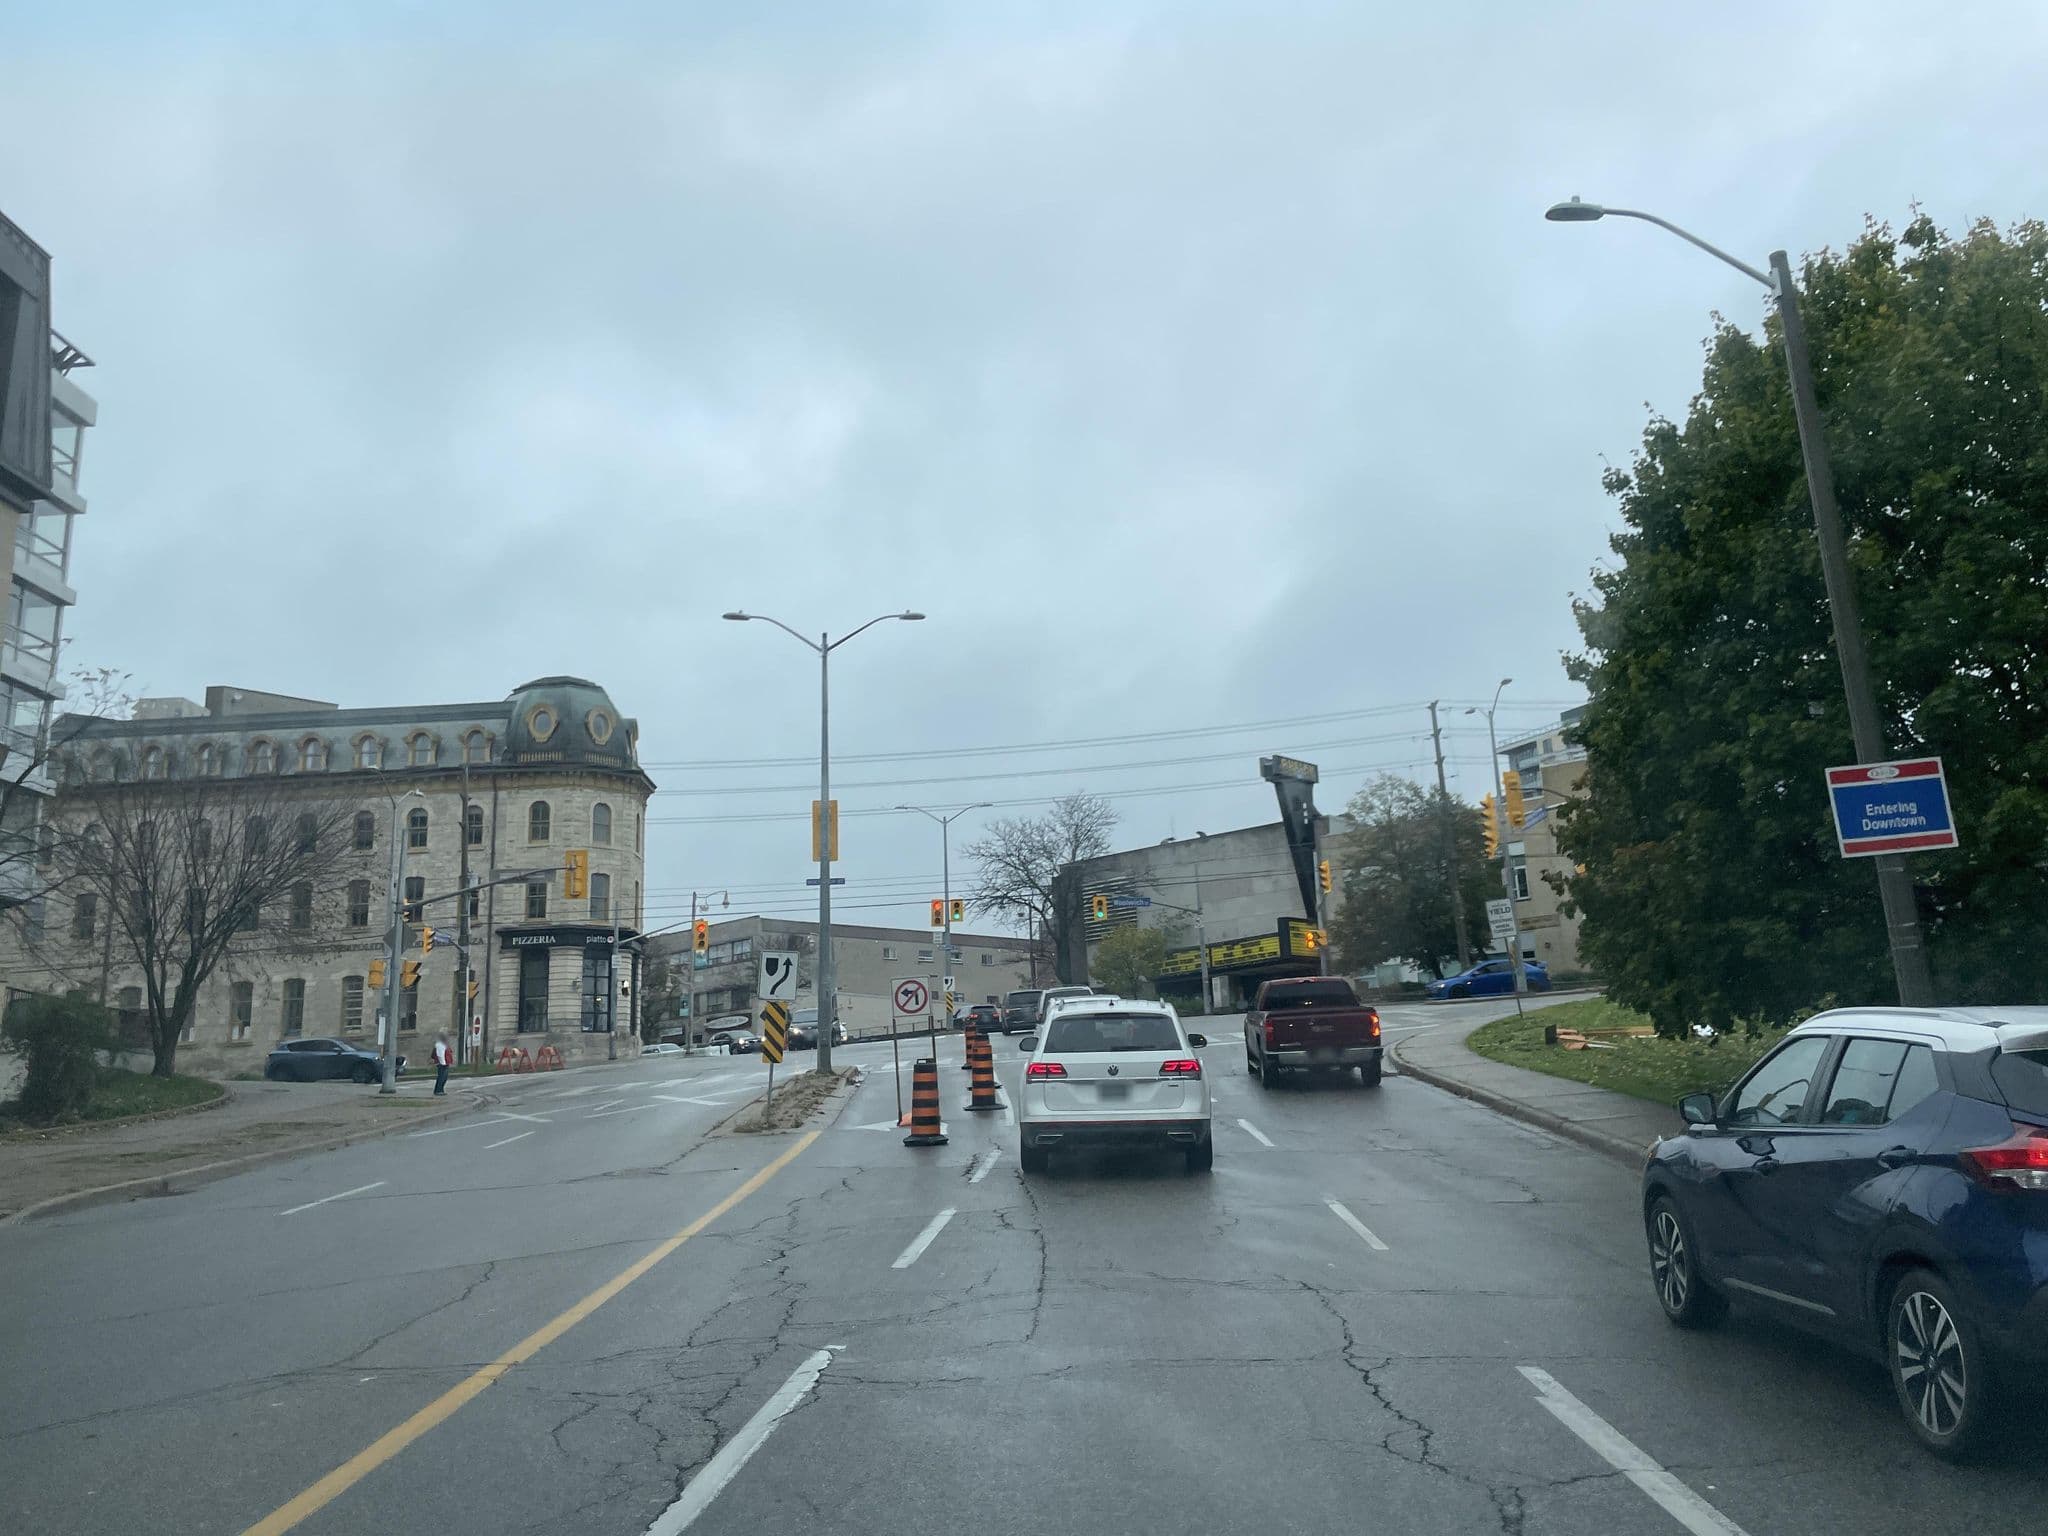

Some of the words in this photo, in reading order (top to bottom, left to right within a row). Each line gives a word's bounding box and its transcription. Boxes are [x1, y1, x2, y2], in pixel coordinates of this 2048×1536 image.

[1865, 801, 1918, 816] Entering
[1862, 815, 1926, 831] Downtown
[1489, 906, 1511, 915] YIELD
[512, 935, 556, 945] PIZZERIA
[586, 934, 607, 944] piatto
